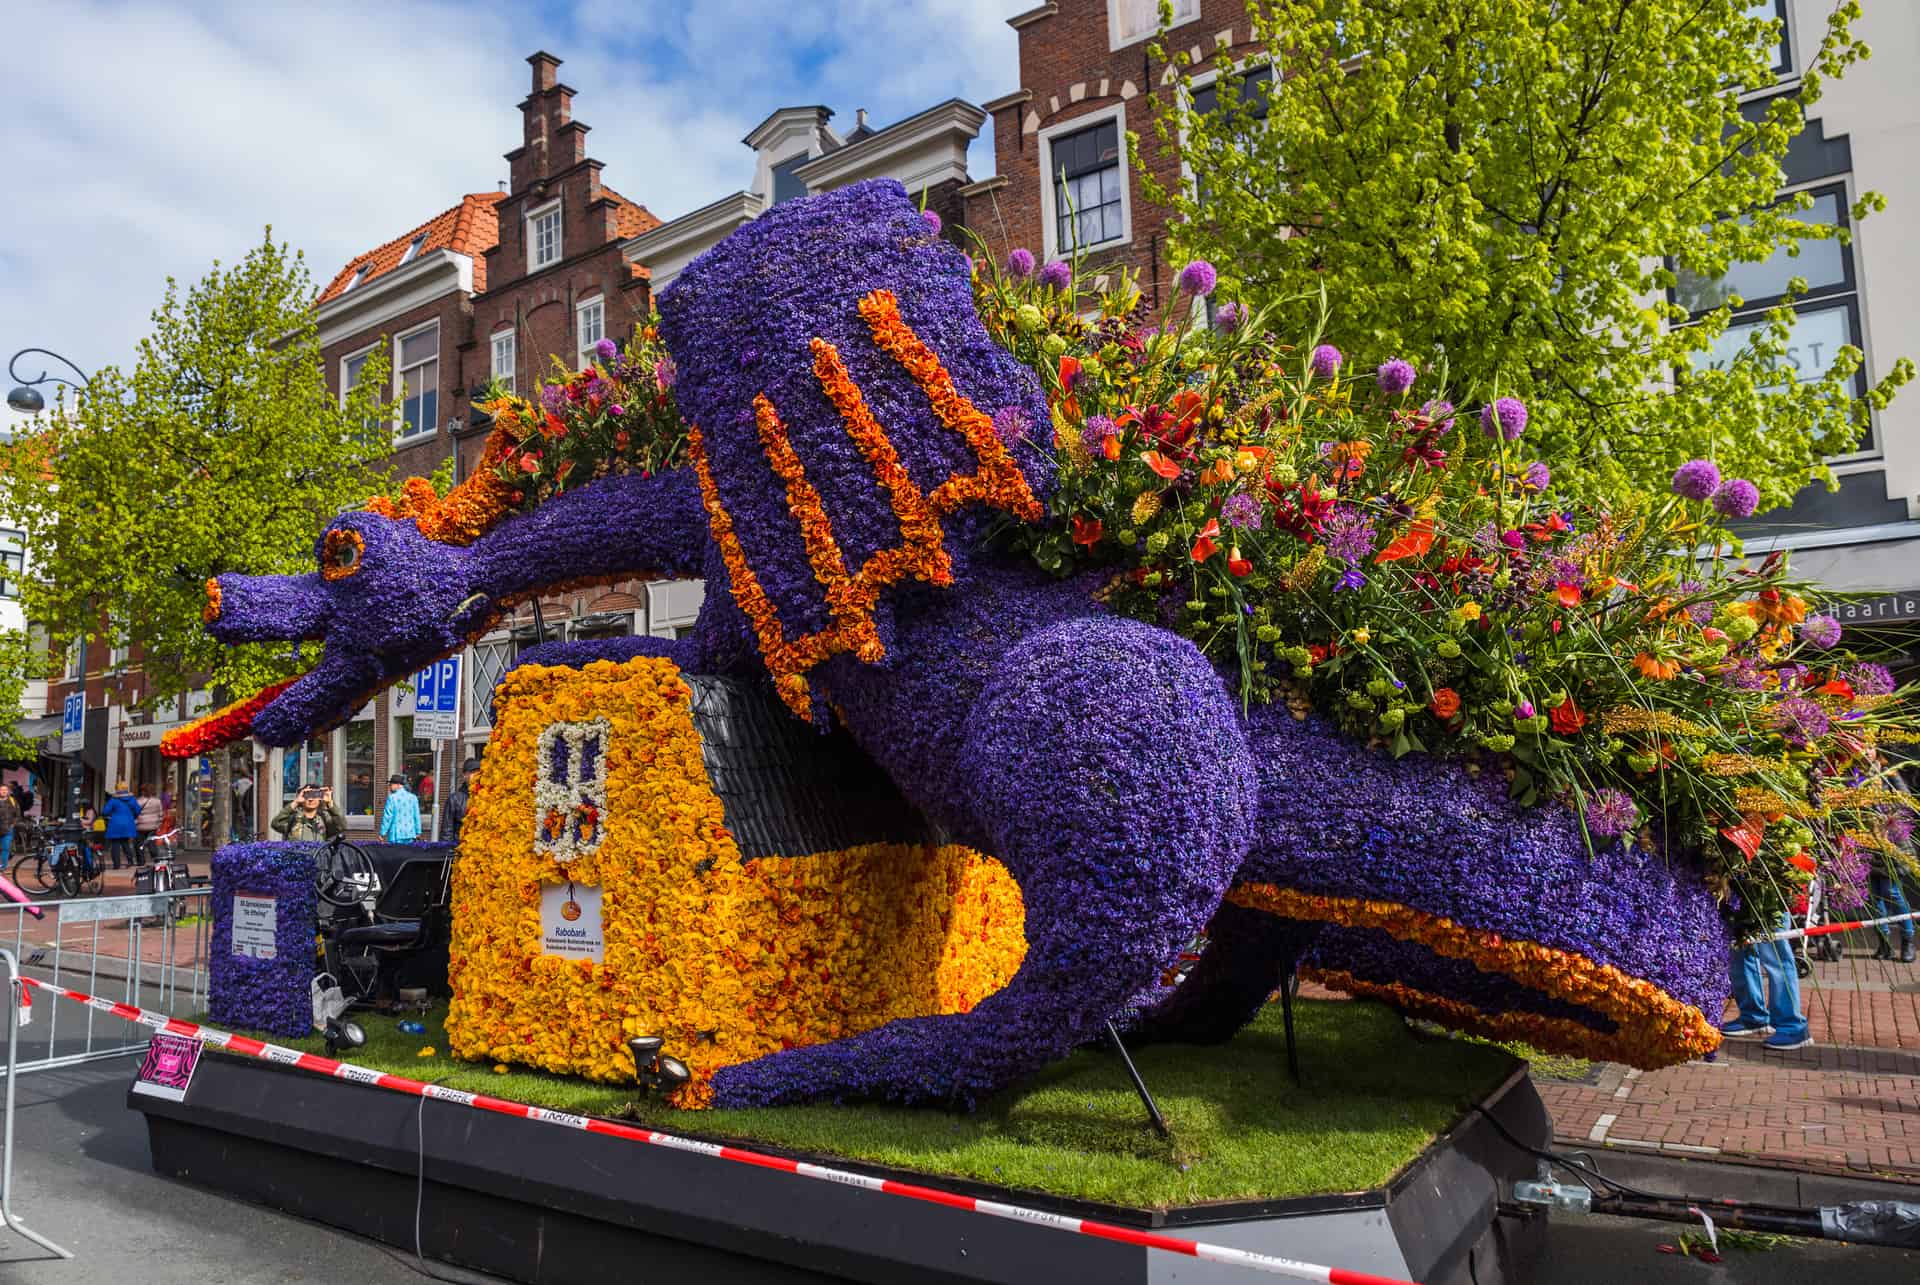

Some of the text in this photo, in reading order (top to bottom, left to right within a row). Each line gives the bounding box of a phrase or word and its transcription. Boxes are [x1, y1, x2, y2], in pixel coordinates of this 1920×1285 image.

[421, 665, 432, 689] P
[441, 663, 454, 689] P
[66, 701, 73, 720] P
[555, 927, 586, 938] Rabobank
[543, 1112, 583, 1125] TRAFFIC
[1012, 1207, 1062, 1225] SUPPORT
